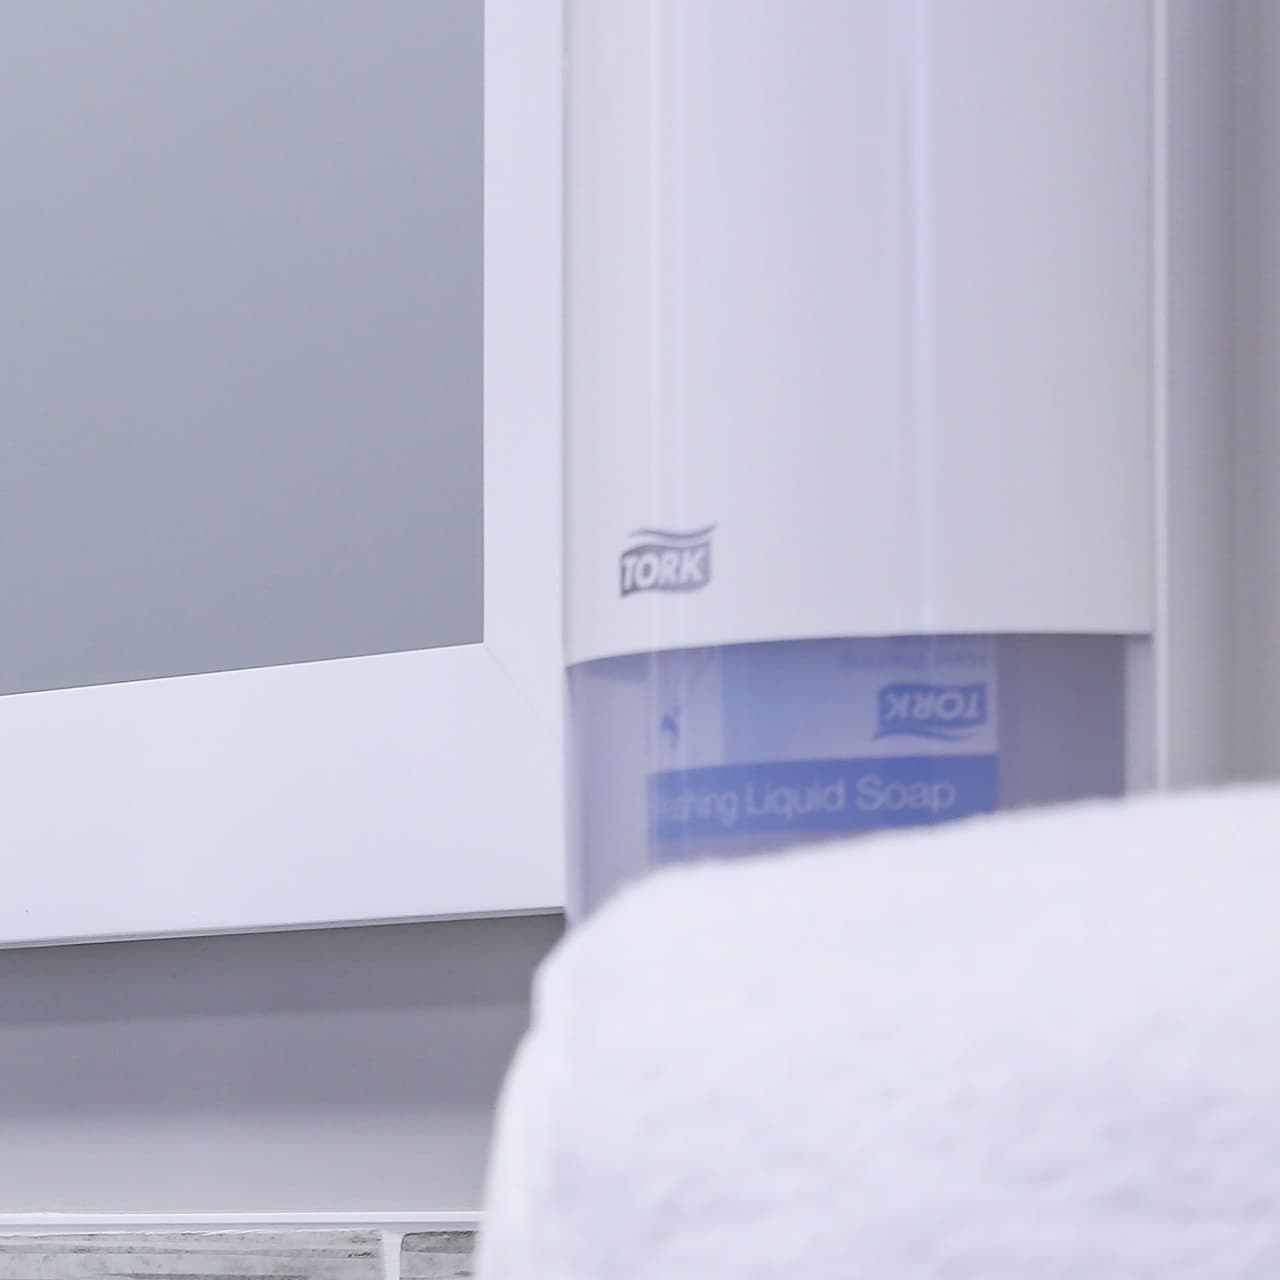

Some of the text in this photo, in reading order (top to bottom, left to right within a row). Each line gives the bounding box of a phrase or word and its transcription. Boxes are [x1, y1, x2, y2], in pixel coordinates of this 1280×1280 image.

[622, 549, 706, 591] TORK
[886, 691, 981, 721] TORK
[746, 778, 845, 820] Liquid
[855, 773, 957, 813] Soap
